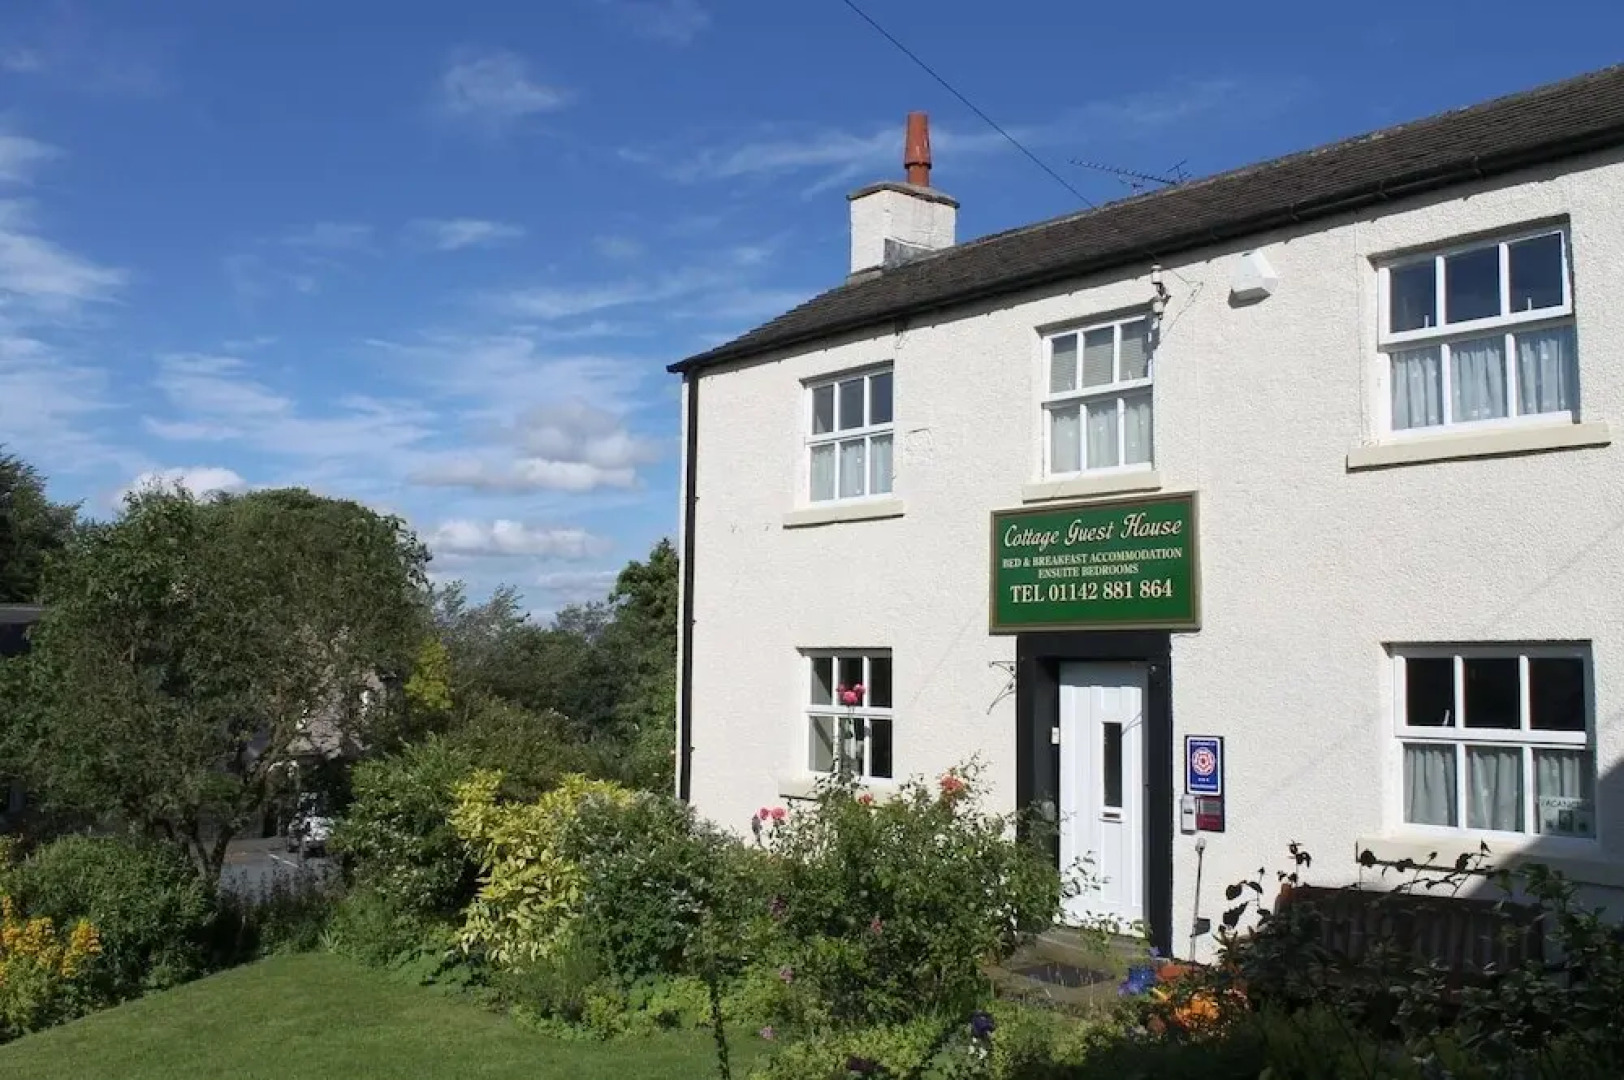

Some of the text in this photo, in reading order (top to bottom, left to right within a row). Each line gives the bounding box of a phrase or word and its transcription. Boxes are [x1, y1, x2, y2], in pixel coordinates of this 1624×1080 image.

[1004, 512, 1182, 551] Cottage Guest House
[1003, 547, 1182, 568] BED & BREAKFAST ACCOMMODATION
[1038, 563, 1139, 579] ENSUITE BEDROOMS
[1010, 578, 1172, 603] TEL 01142 881 864
